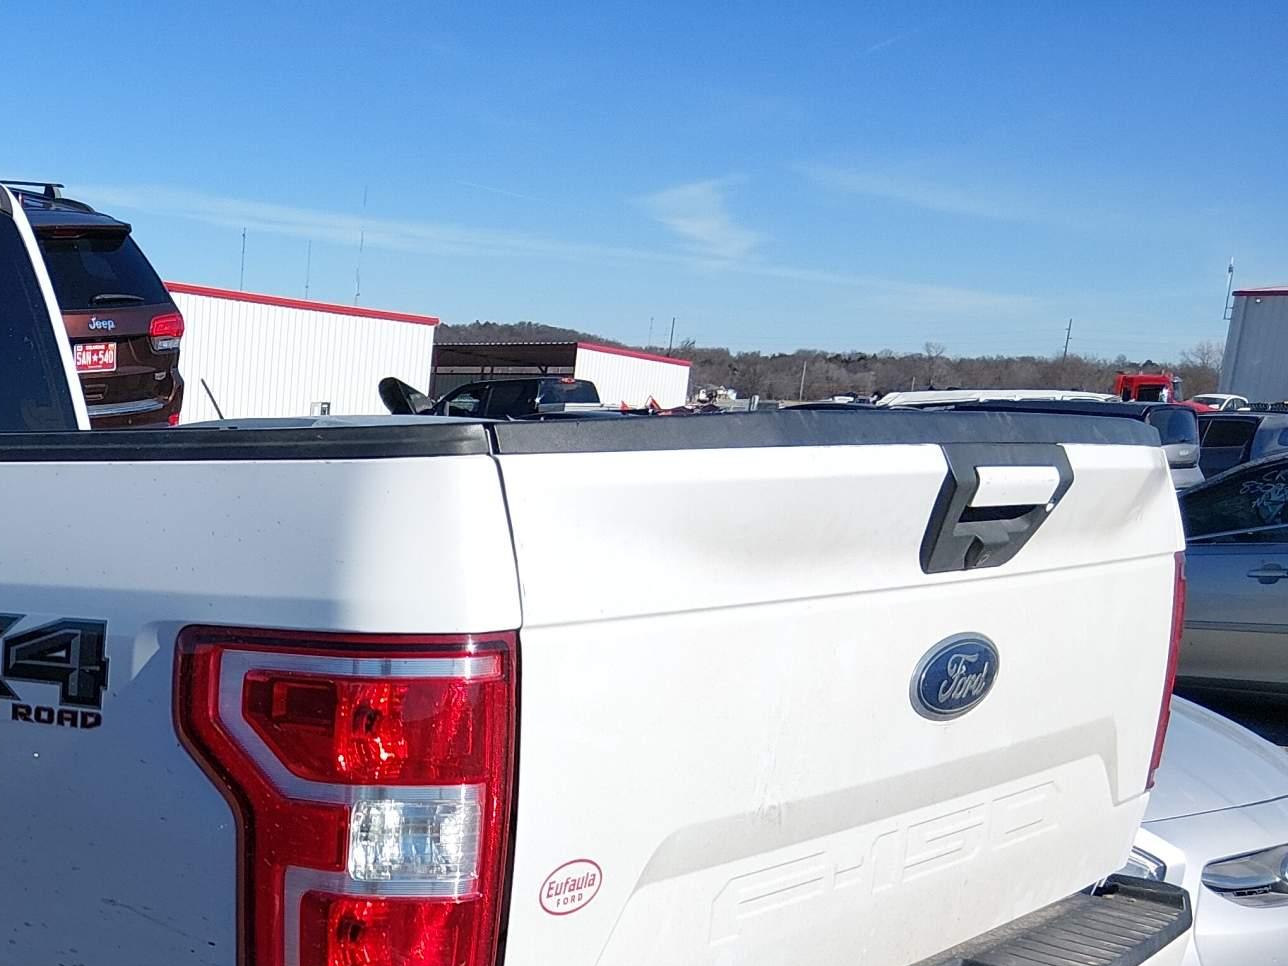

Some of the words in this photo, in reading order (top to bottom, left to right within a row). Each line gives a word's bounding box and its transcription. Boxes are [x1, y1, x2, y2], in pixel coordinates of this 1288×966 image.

[88, 317, 116, 331] Jeep
[937, 652, 989, 704] Ford
[11, 700, 103, 729] ROAD
[546, 872, 596, 899] Eufaula
[556, 893, 583, 908] FORD
